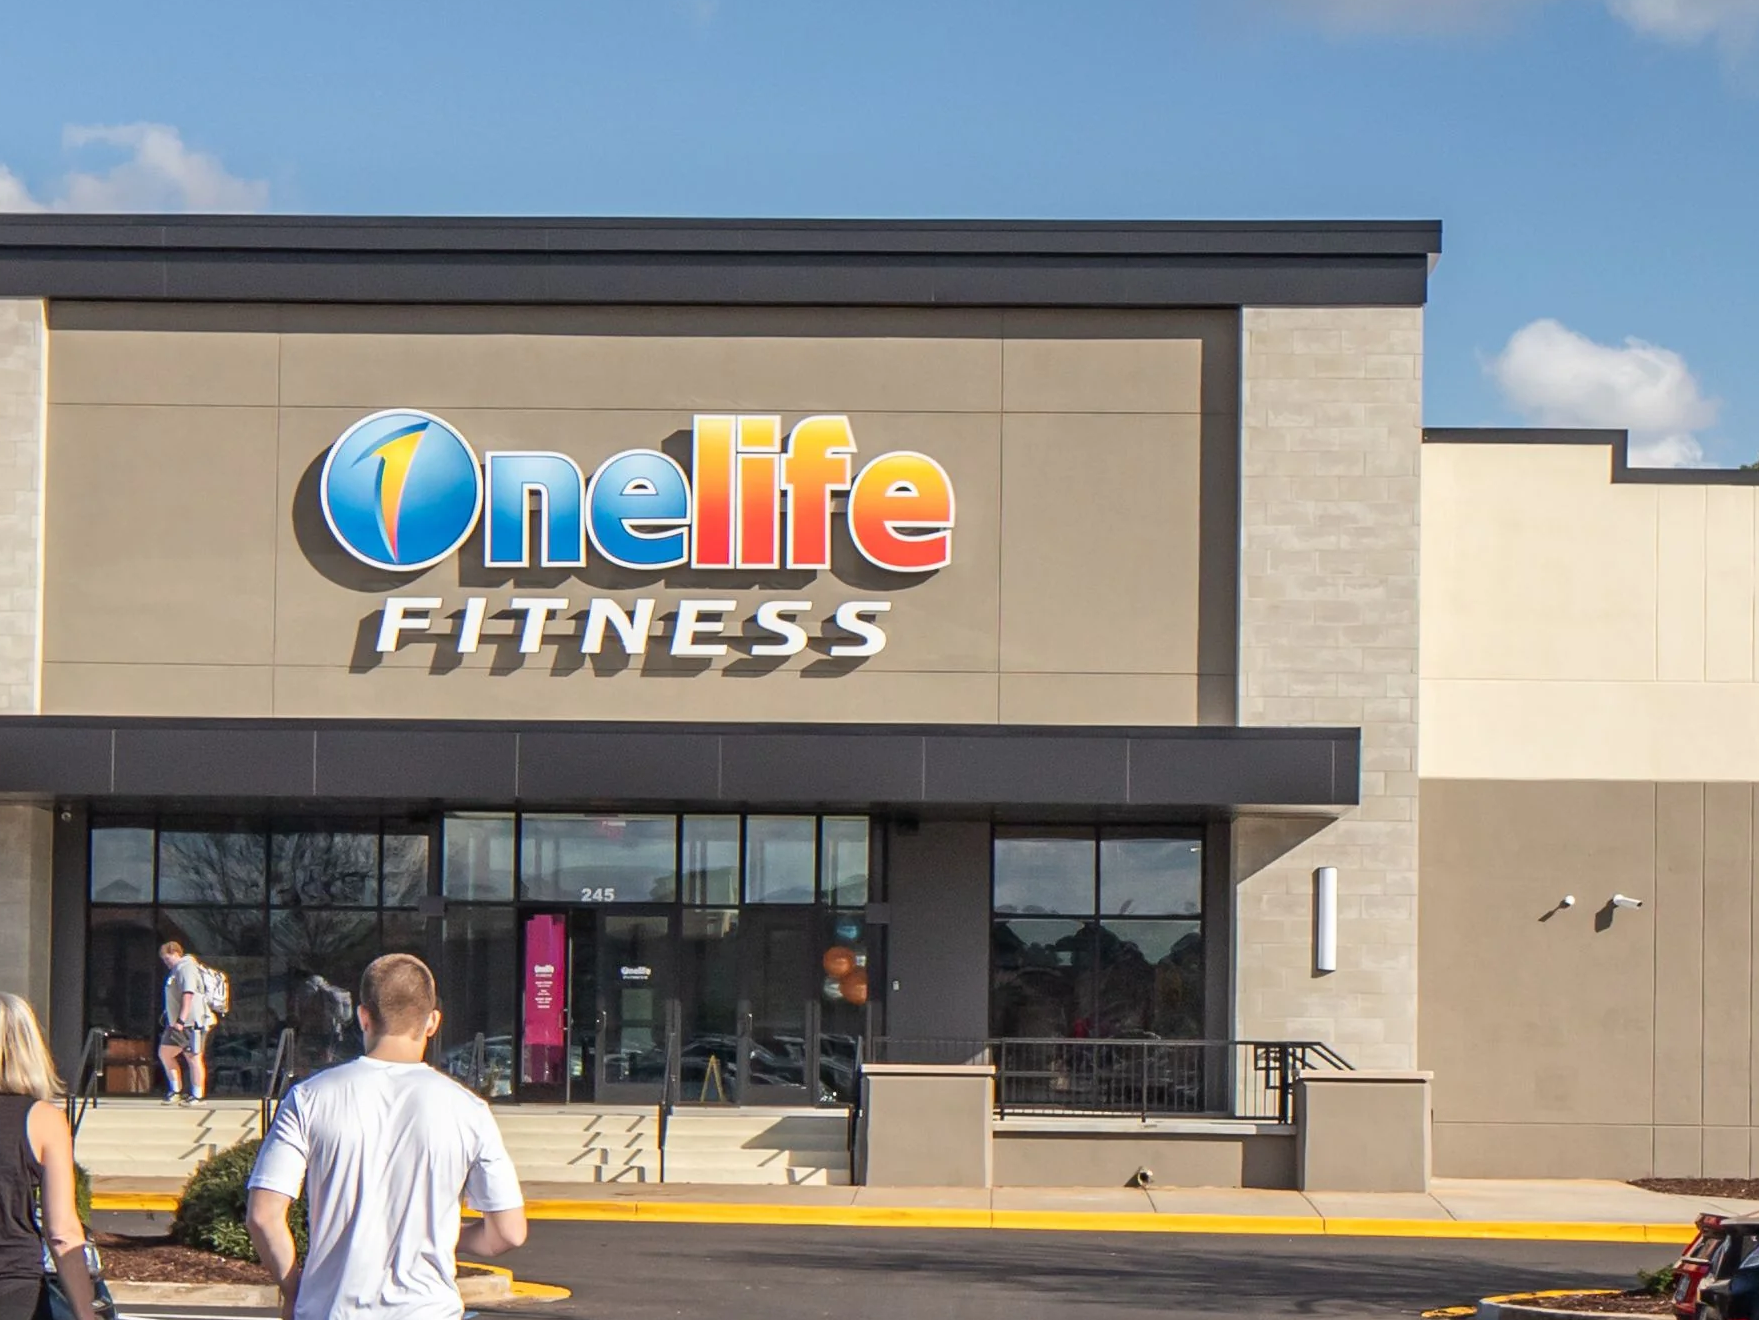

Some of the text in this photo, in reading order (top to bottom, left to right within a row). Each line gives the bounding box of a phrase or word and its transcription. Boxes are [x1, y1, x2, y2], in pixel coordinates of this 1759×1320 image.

[320, 408, 955, 572] Onelife
[375, 597, 892, 657] FITNESS
[580, 887, 616, 902] 245
